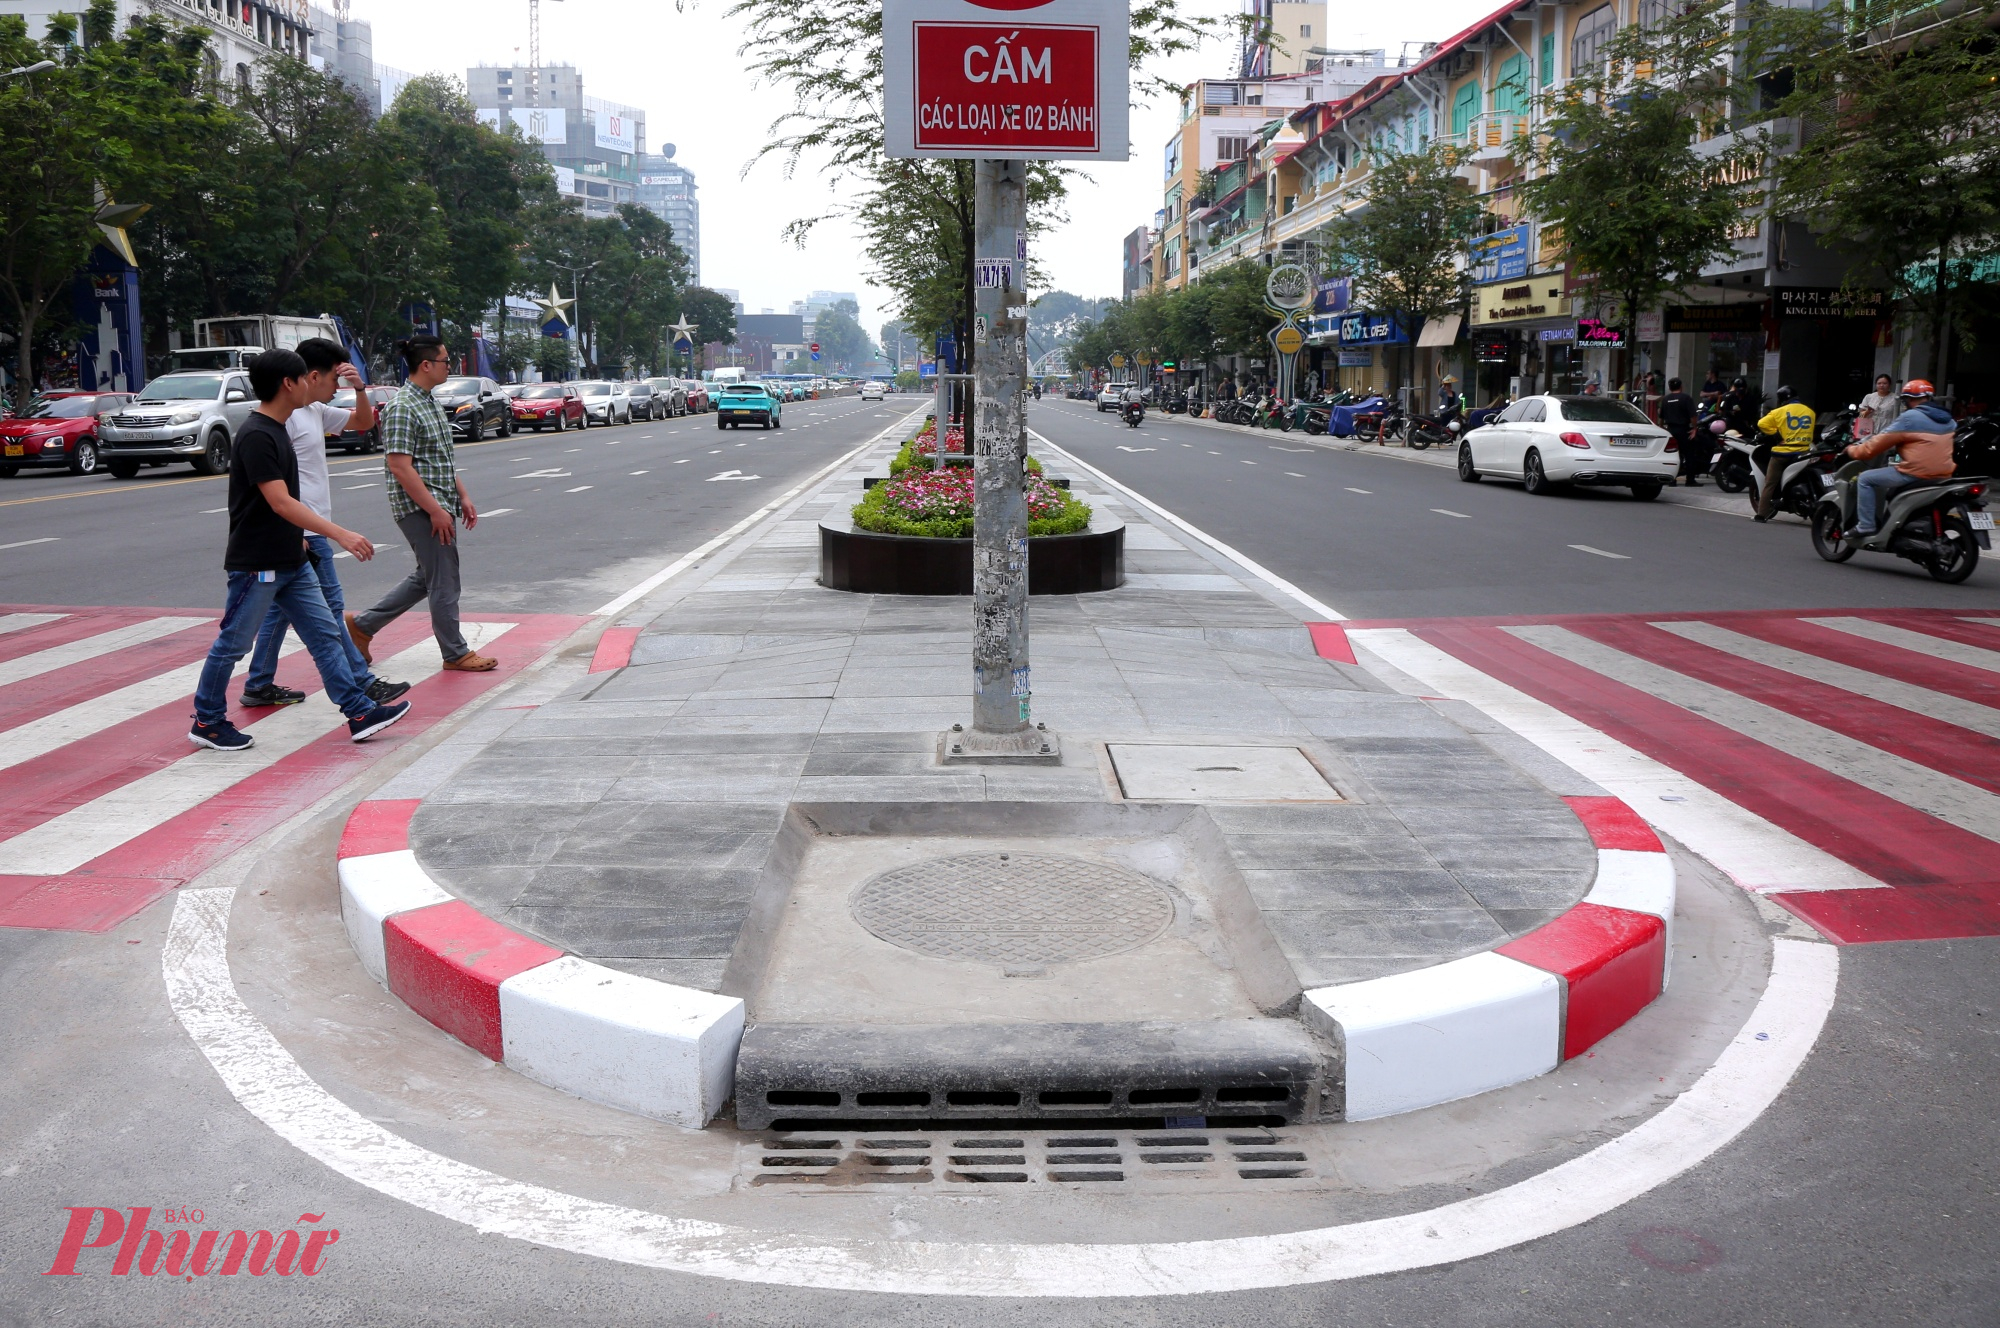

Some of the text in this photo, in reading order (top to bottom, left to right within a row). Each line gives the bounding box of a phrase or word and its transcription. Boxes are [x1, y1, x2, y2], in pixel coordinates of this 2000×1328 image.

[206, 7, 254, 37] BUILDING
[963, 31, 1052, 84] CẤM
[920, 97, 1094, 135] CÁC LOẠI XE 02 BÁNH
[597, 133, 633, 149] NEWTECONS
[95, 288, 119, 297] Bank
[1499, 306, 1526, 318] Chocolate
[1526, 304, 1546, 315] House
[1682, 308, 1745, 319] GUJARAT
[1785, 306, 1877, 317] KING LUXURY BRBER
[1342, 318, 1361, 341] GS25
[1670, 321, 1701, 330] INDIAN
[1539, 330, 1562, 341] VIETNAM
[1786, 411, 1812, 431] be
